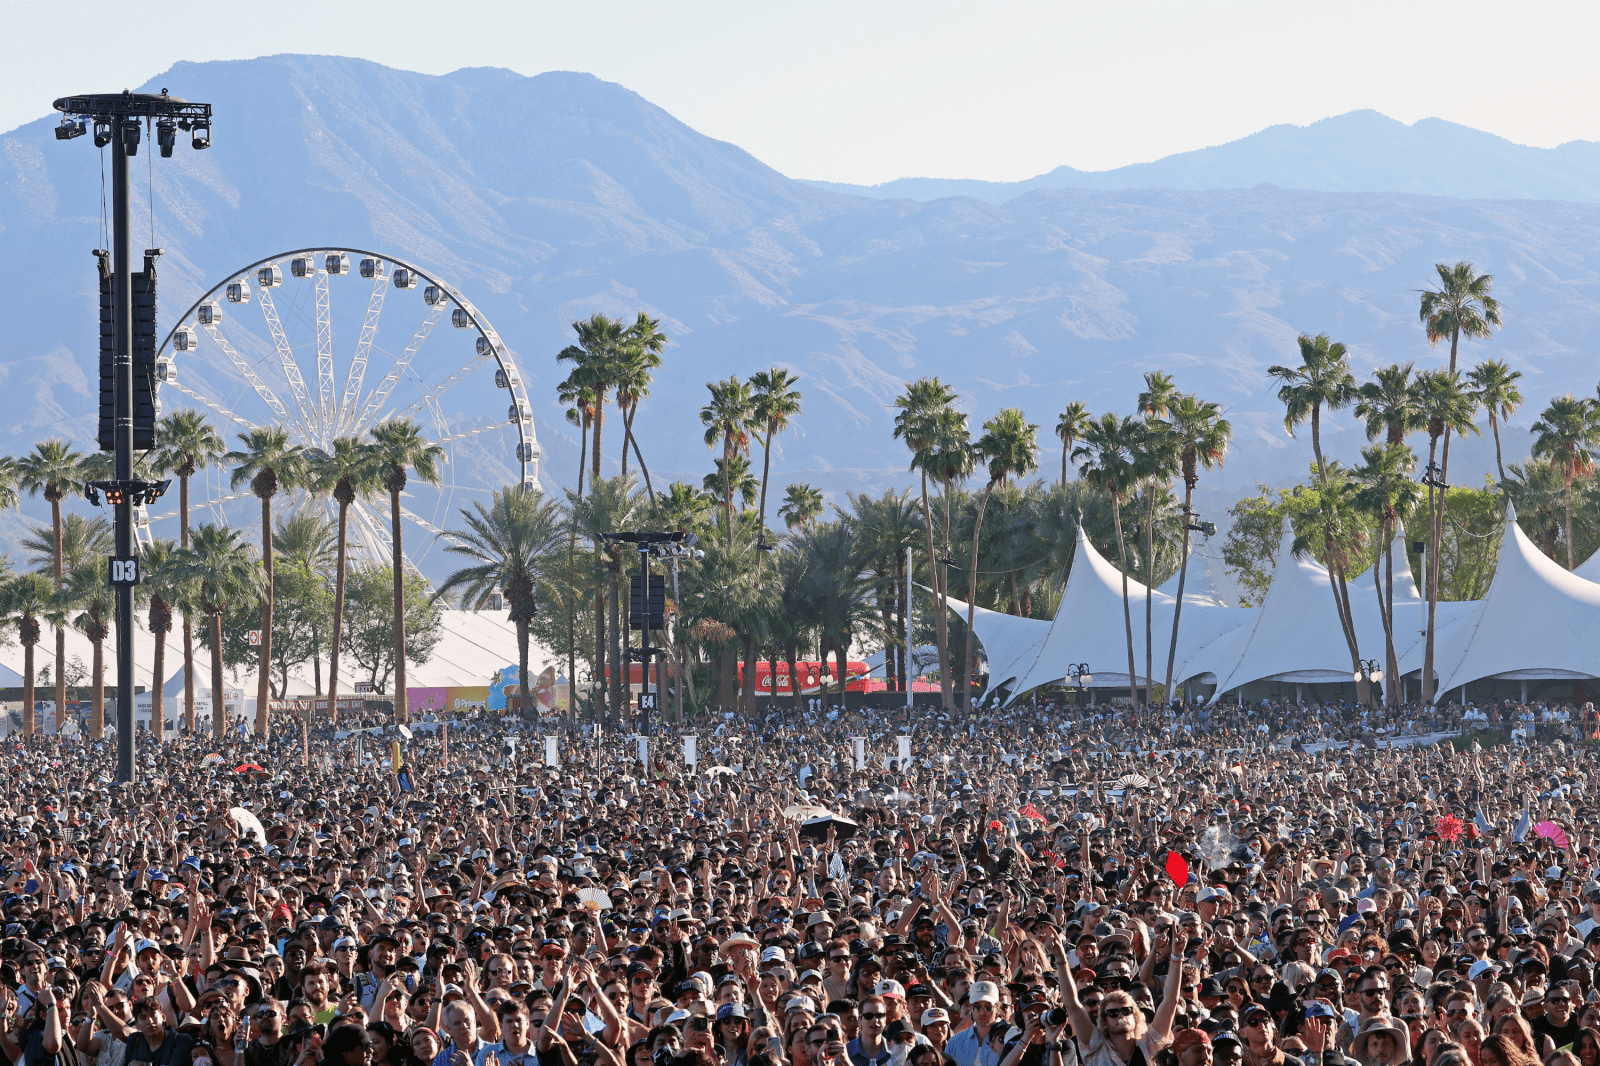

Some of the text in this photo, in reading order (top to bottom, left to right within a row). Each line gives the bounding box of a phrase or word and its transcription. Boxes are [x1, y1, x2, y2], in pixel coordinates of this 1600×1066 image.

[113, 561, 136, 582] D3
[762, 674, 790, 687] CocCola
[642, 695, 654, 708] E4
